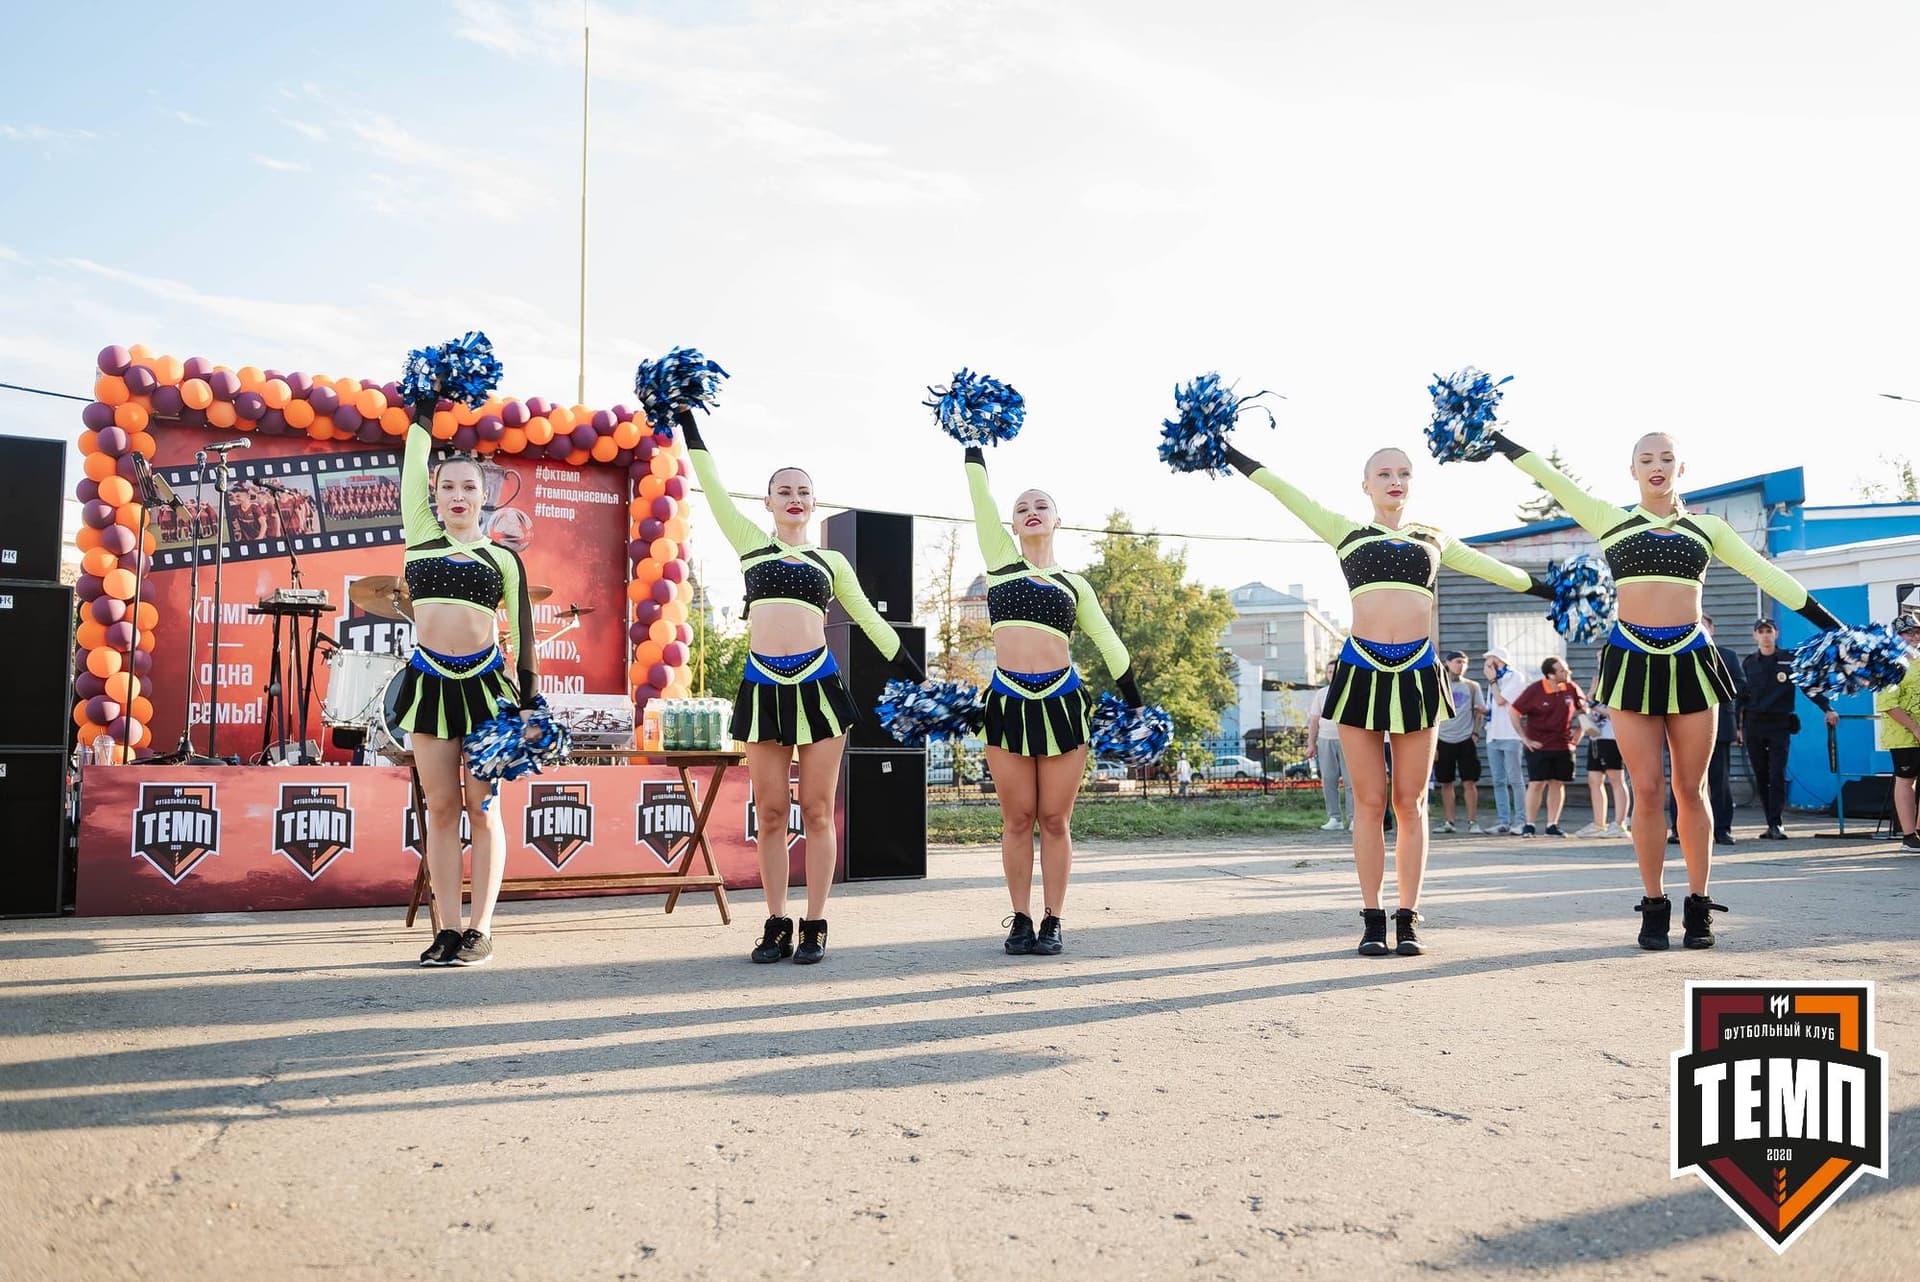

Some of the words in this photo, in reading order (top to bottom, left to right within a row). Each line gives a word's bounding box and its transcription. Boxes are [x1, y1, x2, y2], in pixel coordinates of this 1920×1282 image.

[535, 465, 581, 483] #фктемп
[535, 484, 619, 505] #темподнасемья
[534, 502, 576, 521] #fctemp
[142, 810, 212, 845] ТЕМП
[281, 809, 347, 843] ТЕМП
[530, 806, 587, 838] ТЕМП
[643, 804, 695, 835] ТЕМП
